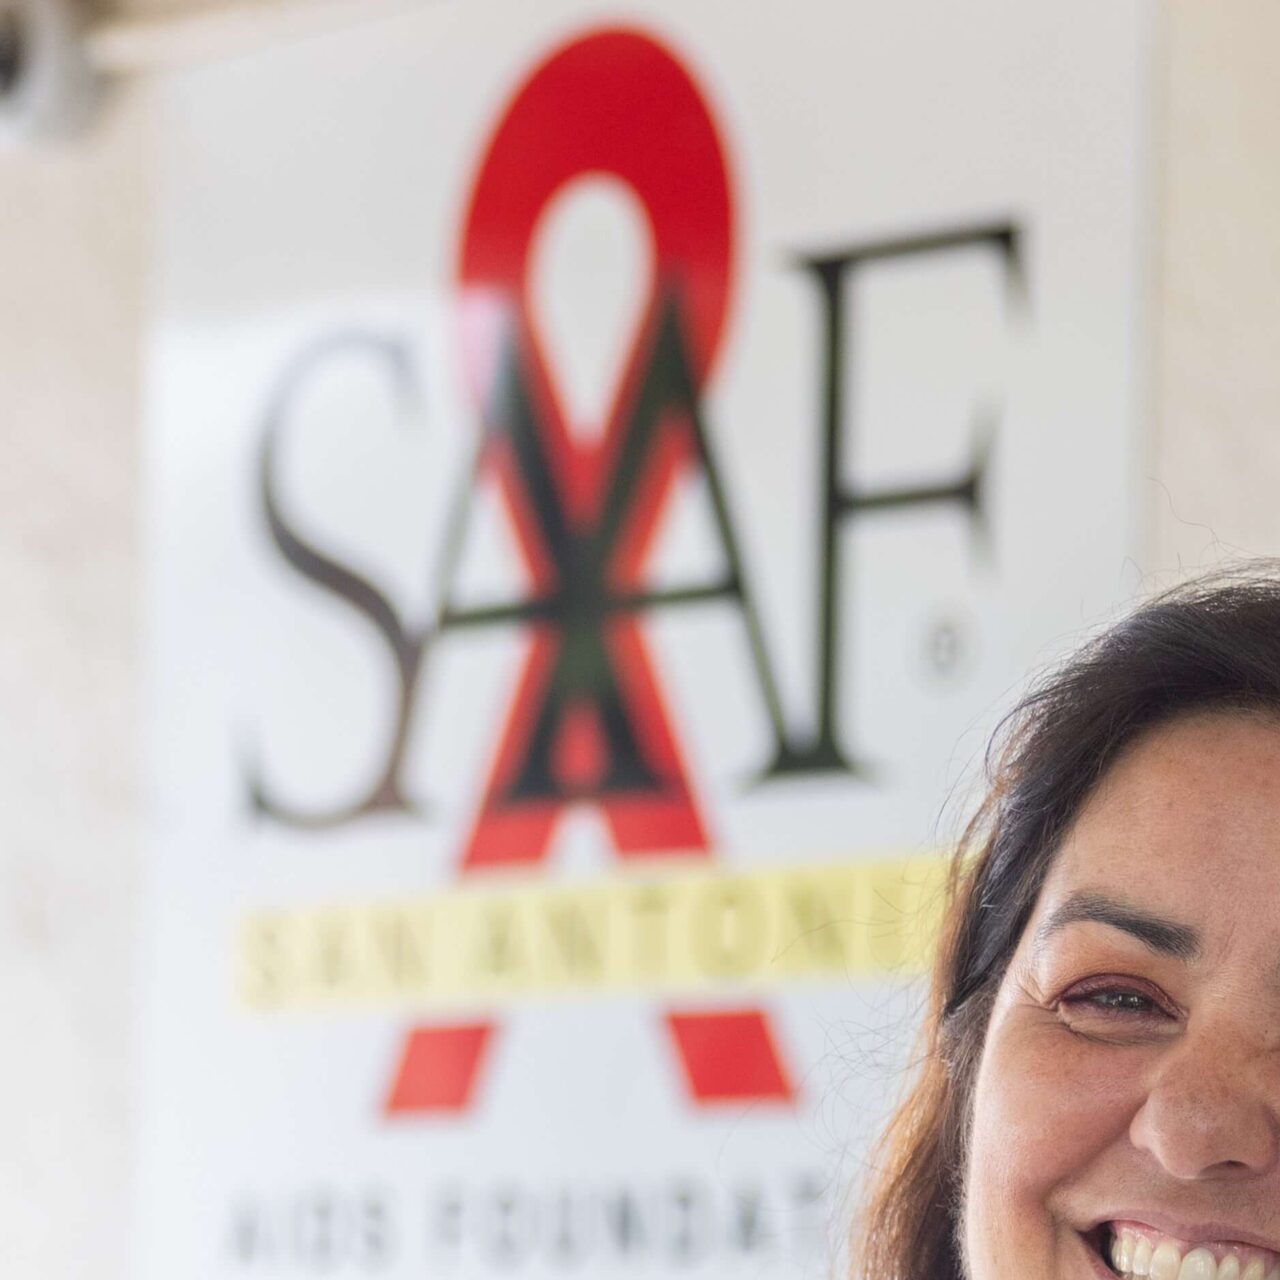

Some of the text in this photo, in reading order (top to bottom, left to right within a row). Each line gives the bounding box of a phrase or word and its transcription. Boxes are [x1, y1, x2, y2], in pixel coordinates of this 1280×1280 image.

[233, 212, 1033, 832] SAAF
[244, 868, 908, 1003] SAN ANTONI
[228, 1172, 830, 1266] AIDS FOUNDAT
